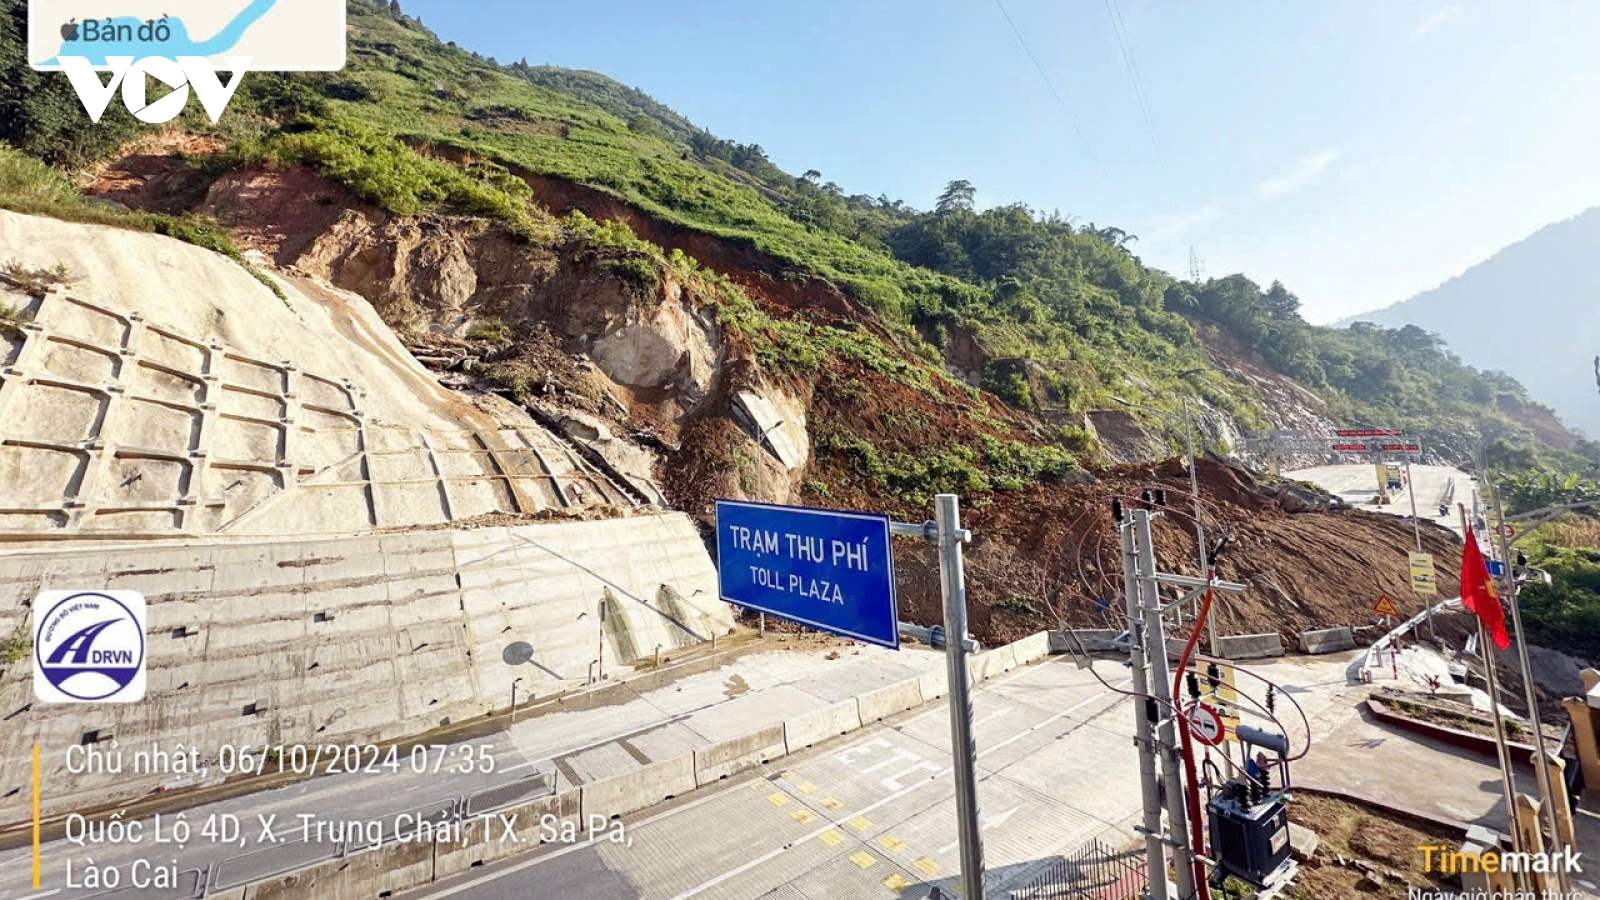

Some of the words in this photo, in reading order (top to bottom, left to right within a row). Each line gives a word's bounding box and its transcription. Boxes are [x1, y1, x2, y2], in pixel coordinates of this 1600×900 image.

[730, 525, 779, 557] TRẠM
[785, 533, 824, 563] THU
[831, 536, 869, 571] PHÍ
[750, 566, 785, 591] TOLL
[789, 574, 844, 605] PLAZA
